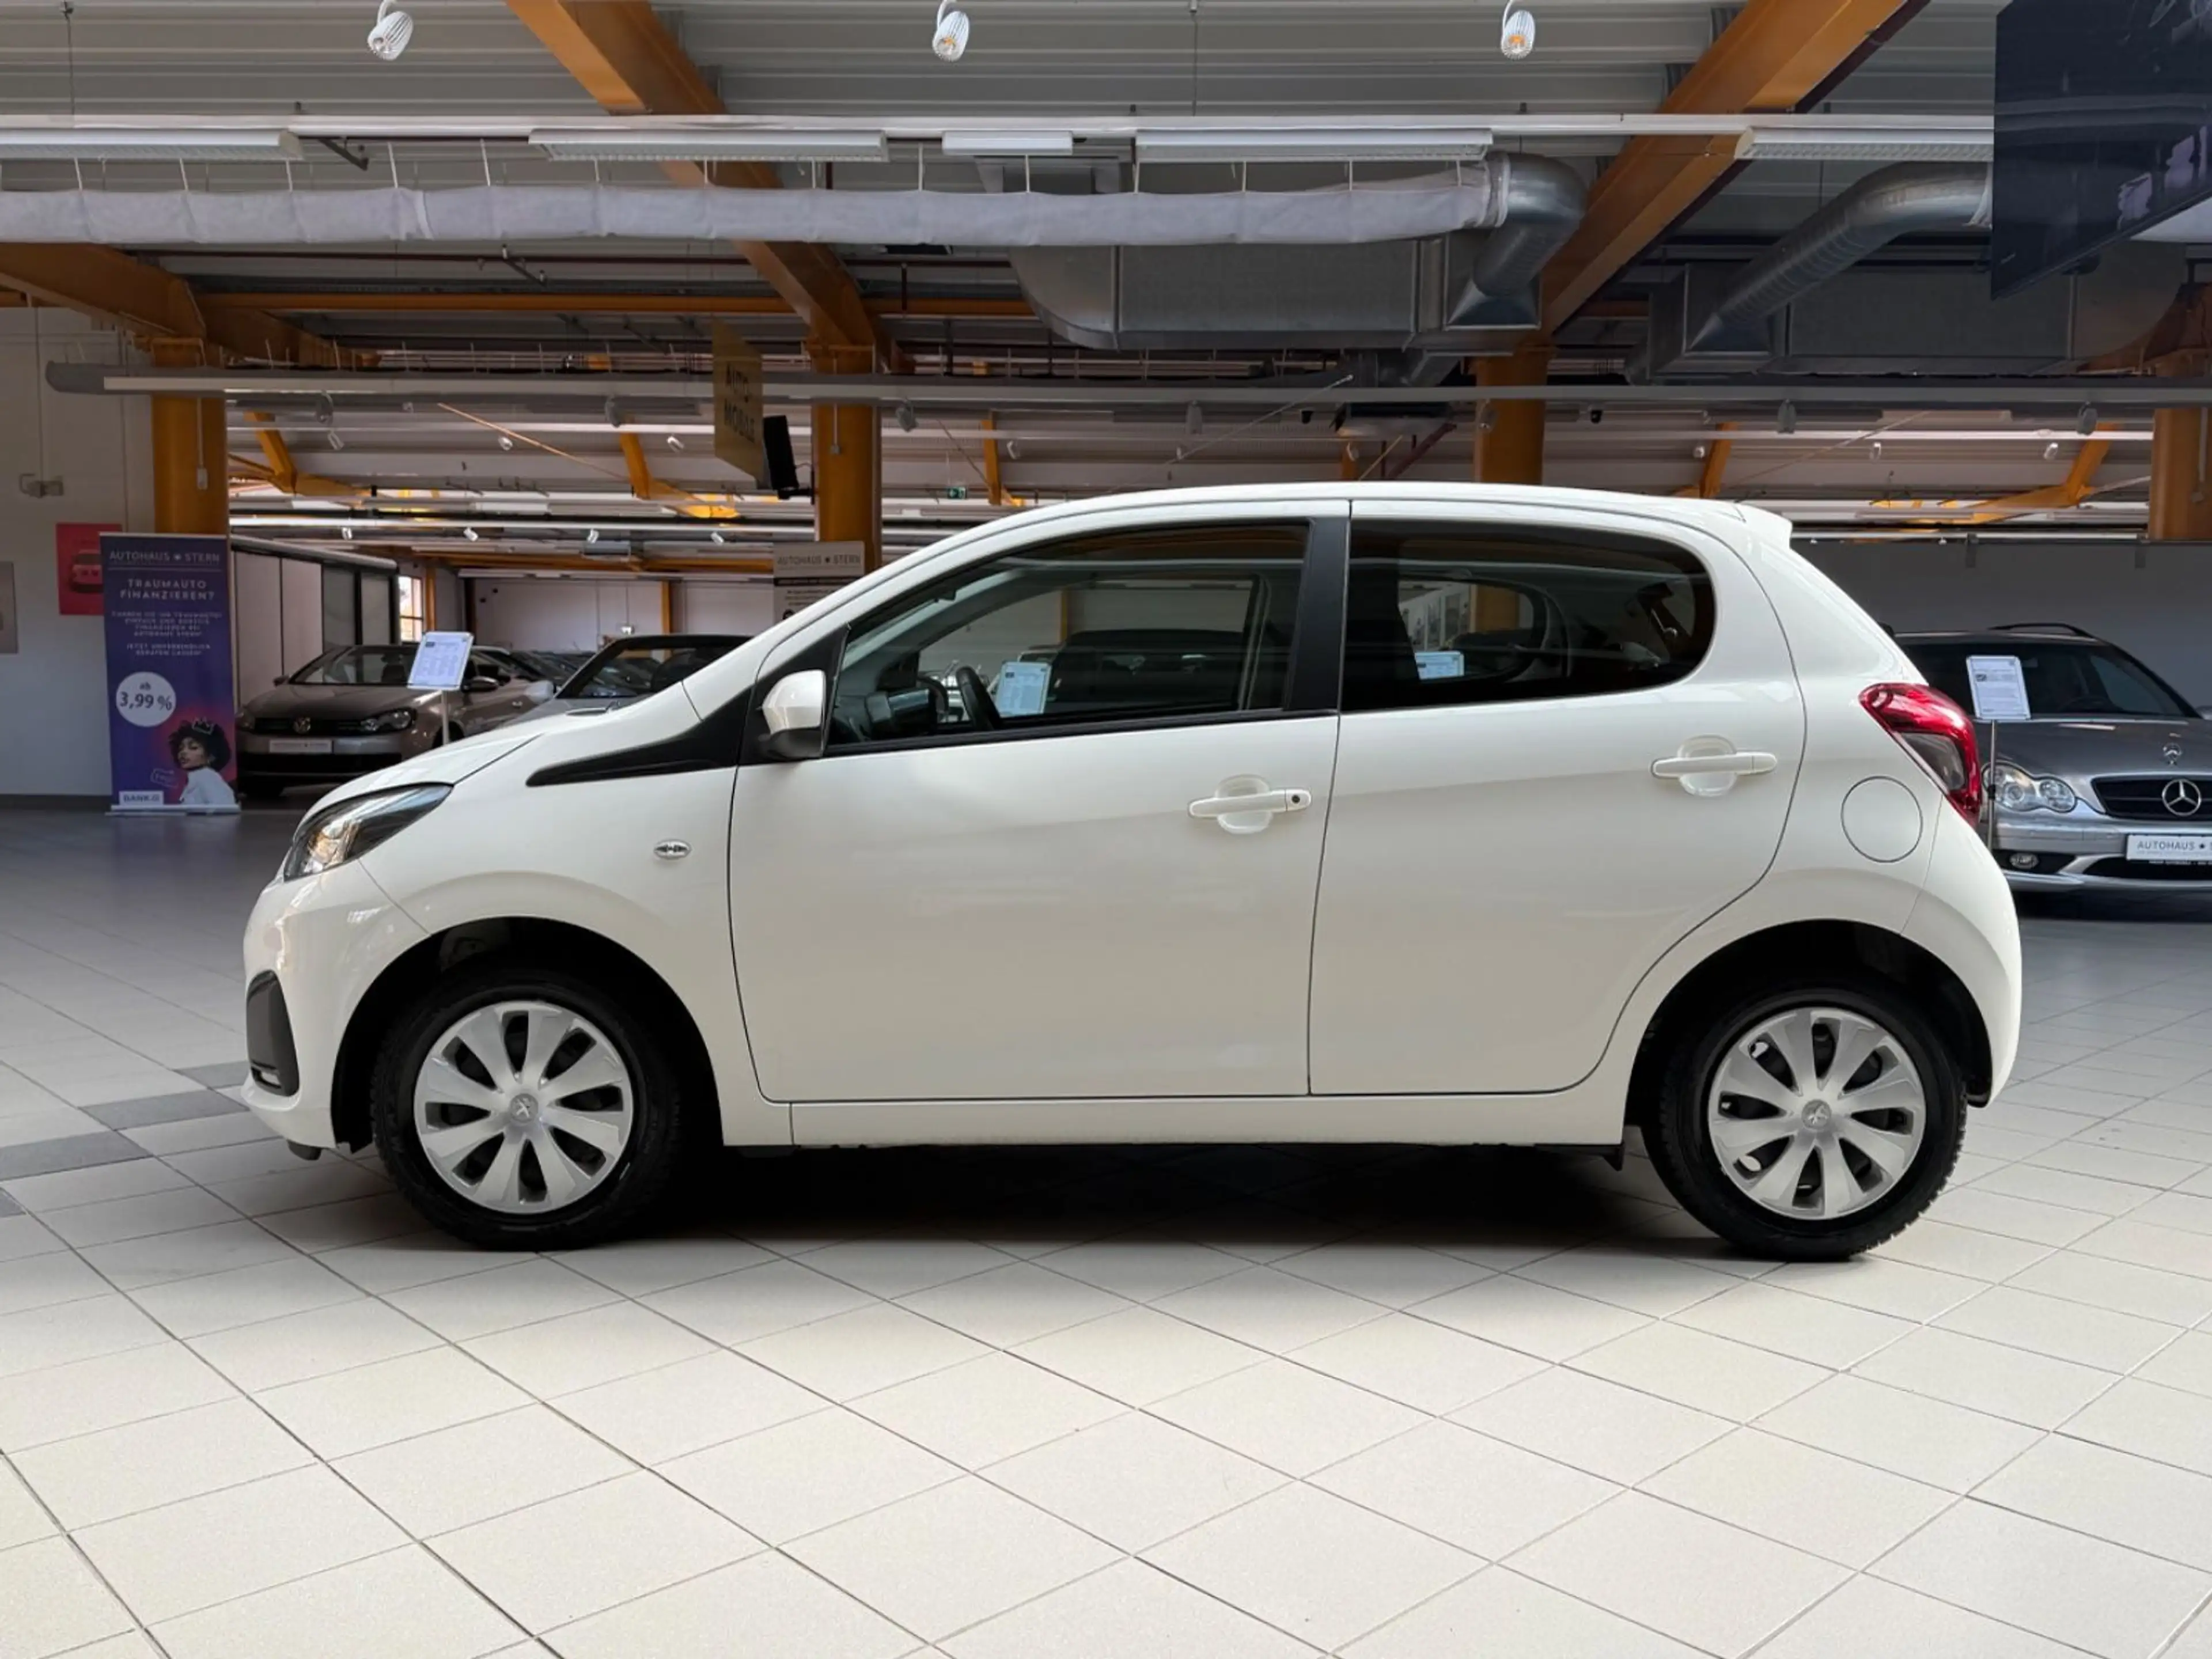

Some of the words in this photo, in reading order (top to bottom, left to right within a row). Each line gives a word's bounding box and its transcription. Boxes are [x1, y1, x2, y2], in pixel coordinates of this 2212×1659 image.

[109, 550, 170, 561] AUTOHAUS
[184, 552, 220, 562] STERN
[127, 578, 207, 589] TRAUMAUTO
[120, 589, 215, 601] FINANZIEREN?
[139, 681, 151, 690] ab
[119, 692, 154, 709] 3,99
[2137, 840, 2195, 851] AUTOHAUS
